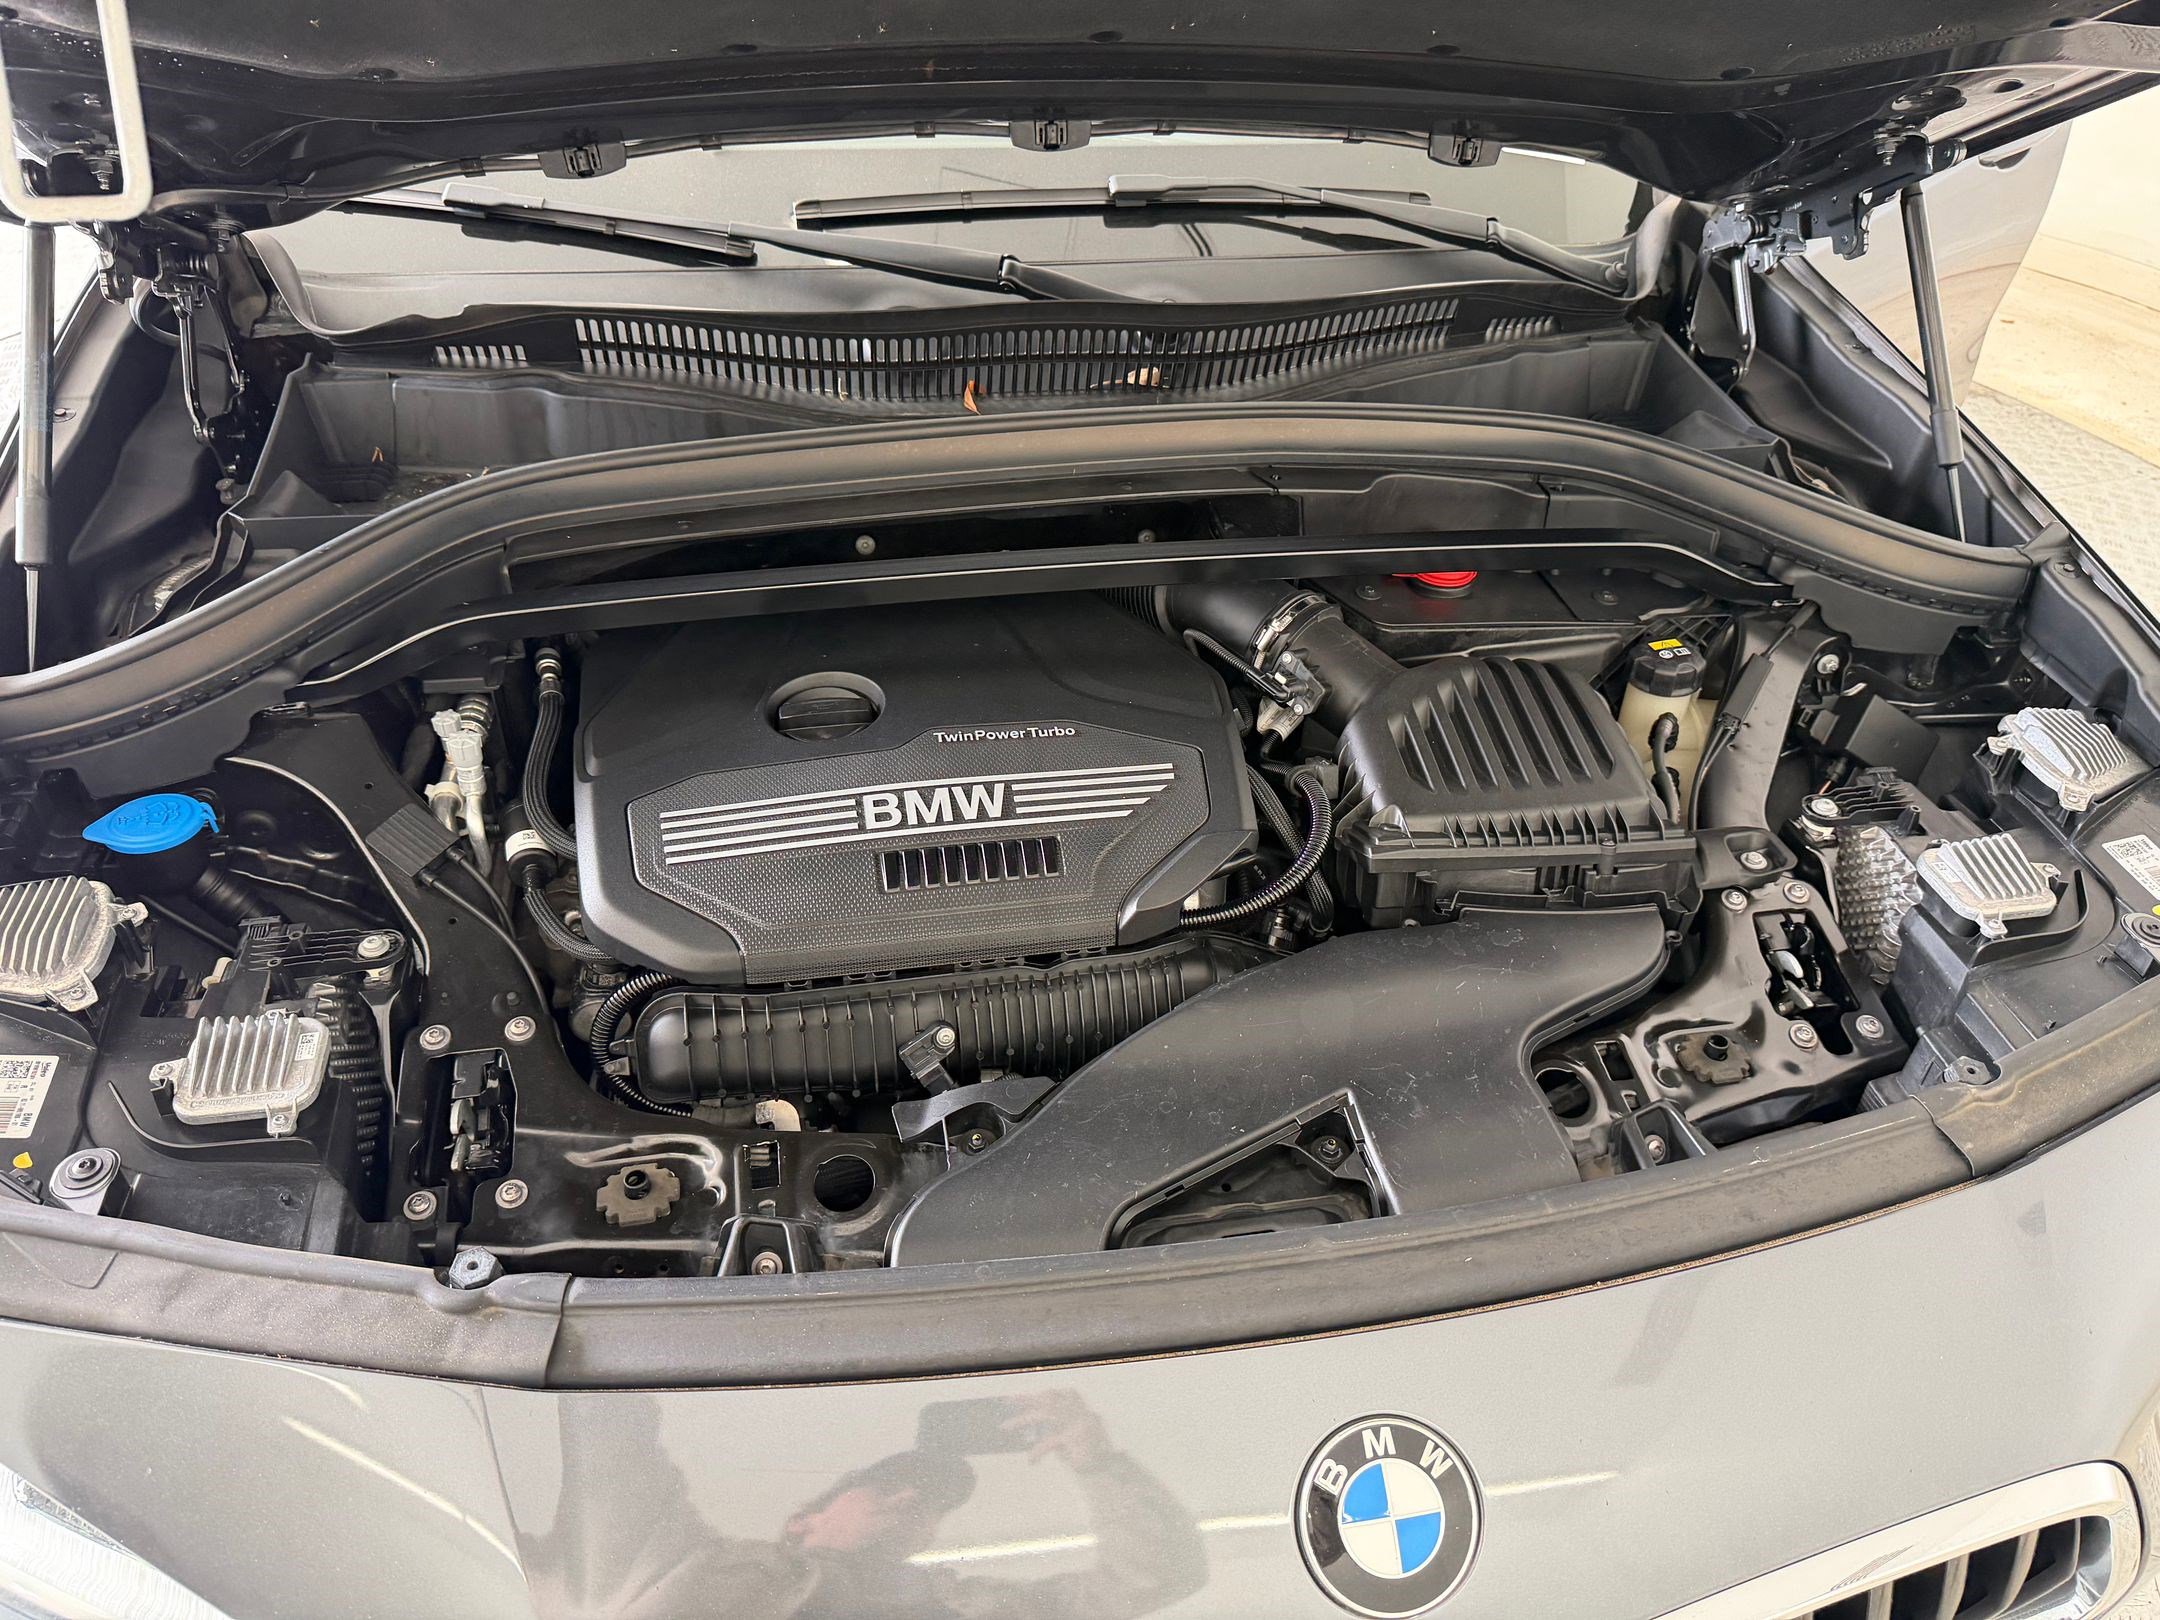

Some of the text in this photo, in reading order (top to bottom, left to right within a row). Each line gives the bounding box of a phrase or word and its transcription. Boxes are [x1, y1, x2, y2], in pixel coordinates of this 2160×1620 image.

[1026, 726, 1076, 738] Turbo
[862, 782, 1005, 830] BMW
[1313, 1426, 1454, 1497] BMW
